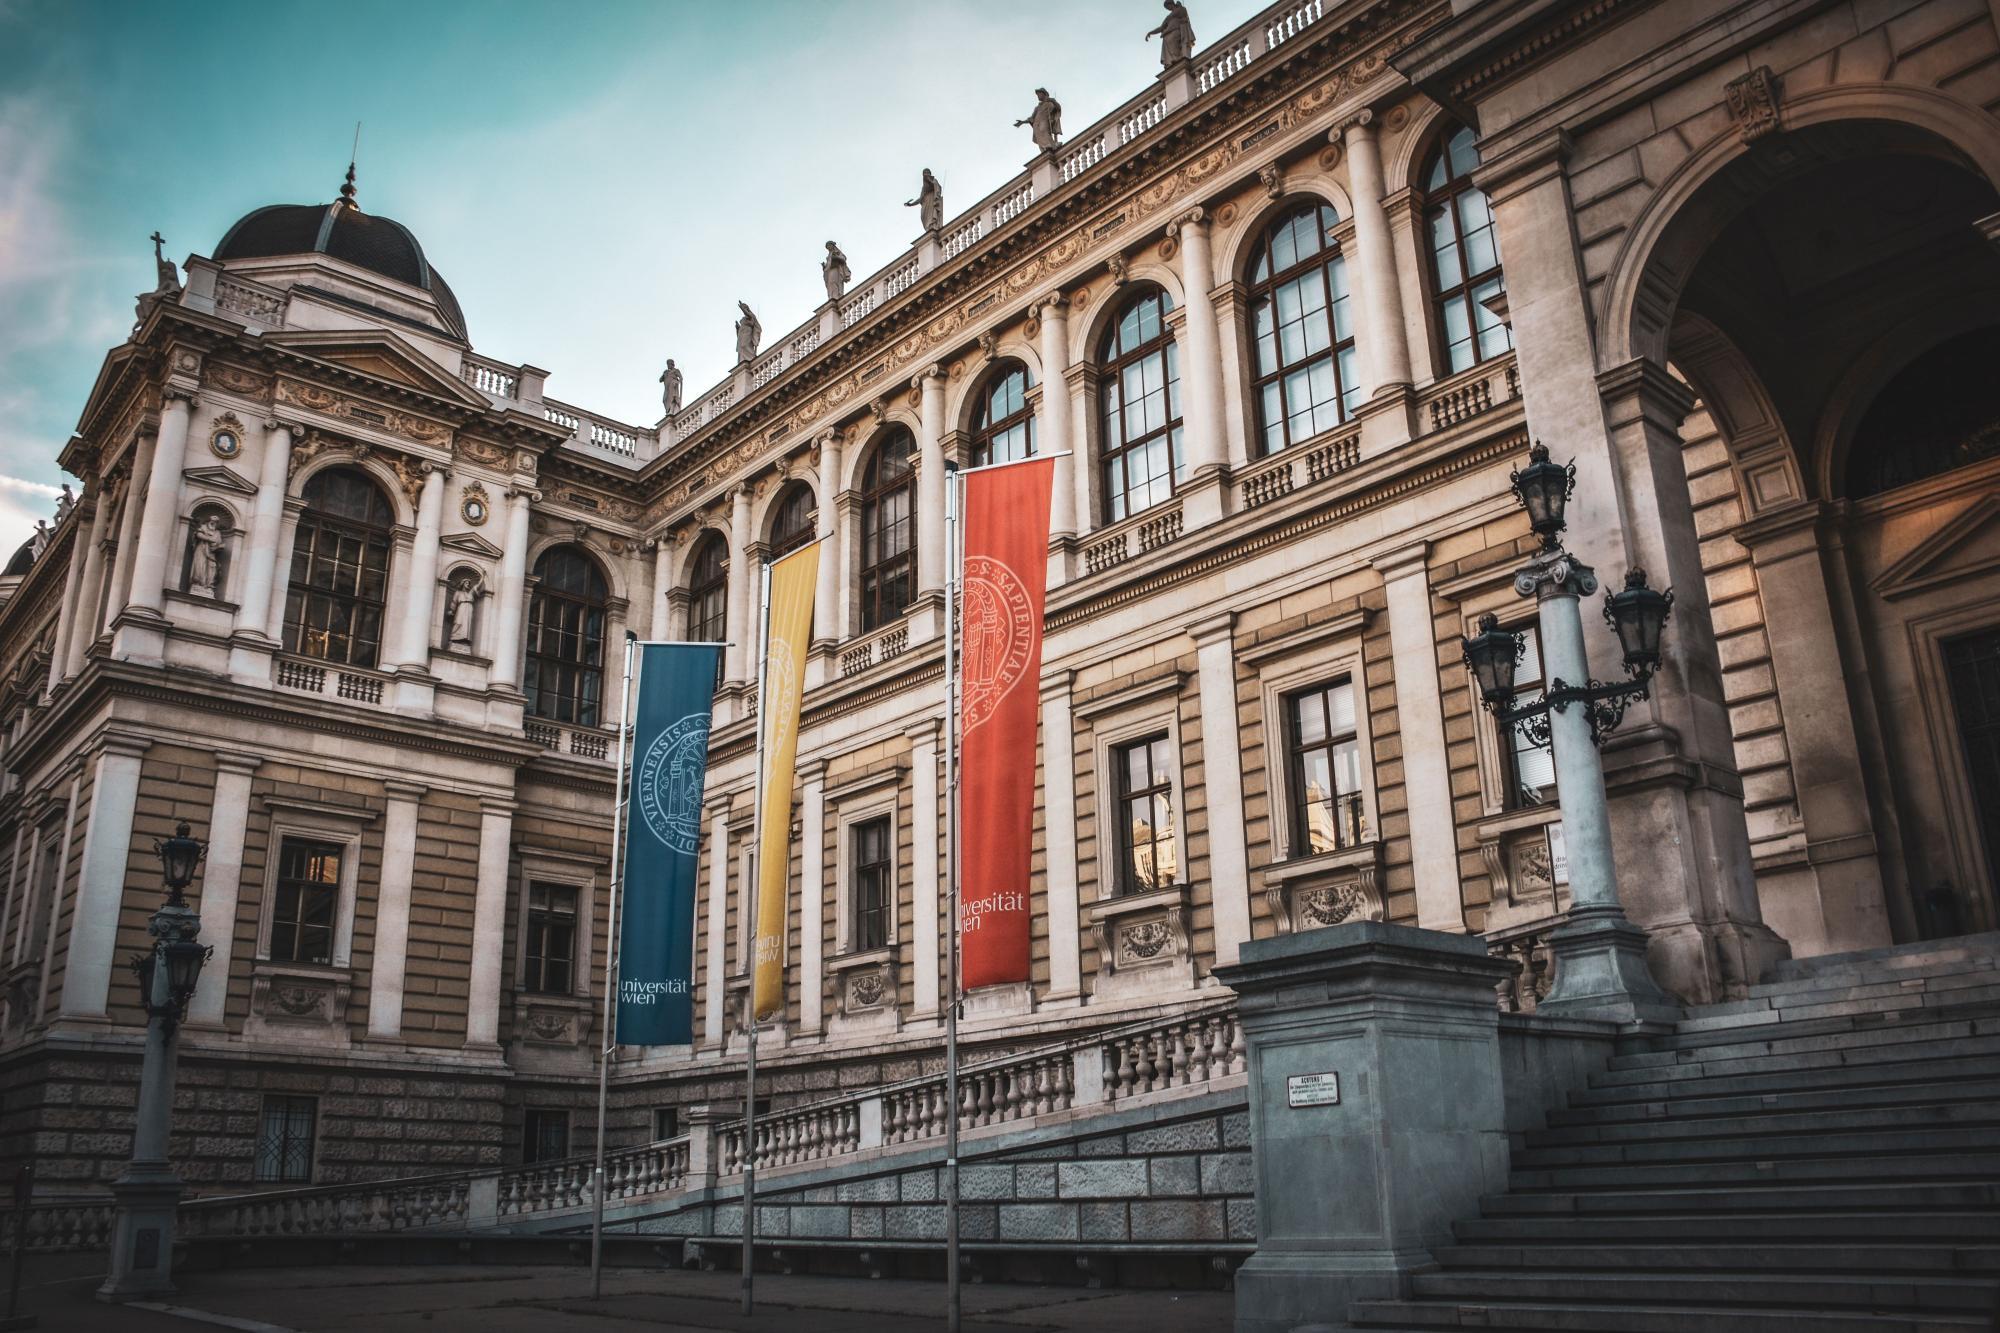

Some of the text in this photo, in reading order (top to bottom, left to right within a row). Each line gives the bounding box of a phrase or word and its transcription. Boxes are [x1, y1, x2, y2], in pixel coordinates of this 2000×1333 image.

[997, 572, 1030, 684] SAPIENTIAE
[643, 727, 681, 820] VIENNENSIS
[961, 891, 1024, 917] iversität
[962, 915, 980, 933] ien
[620, 978, 688, 994] universität
[621, 992, 656, 1005] wien
